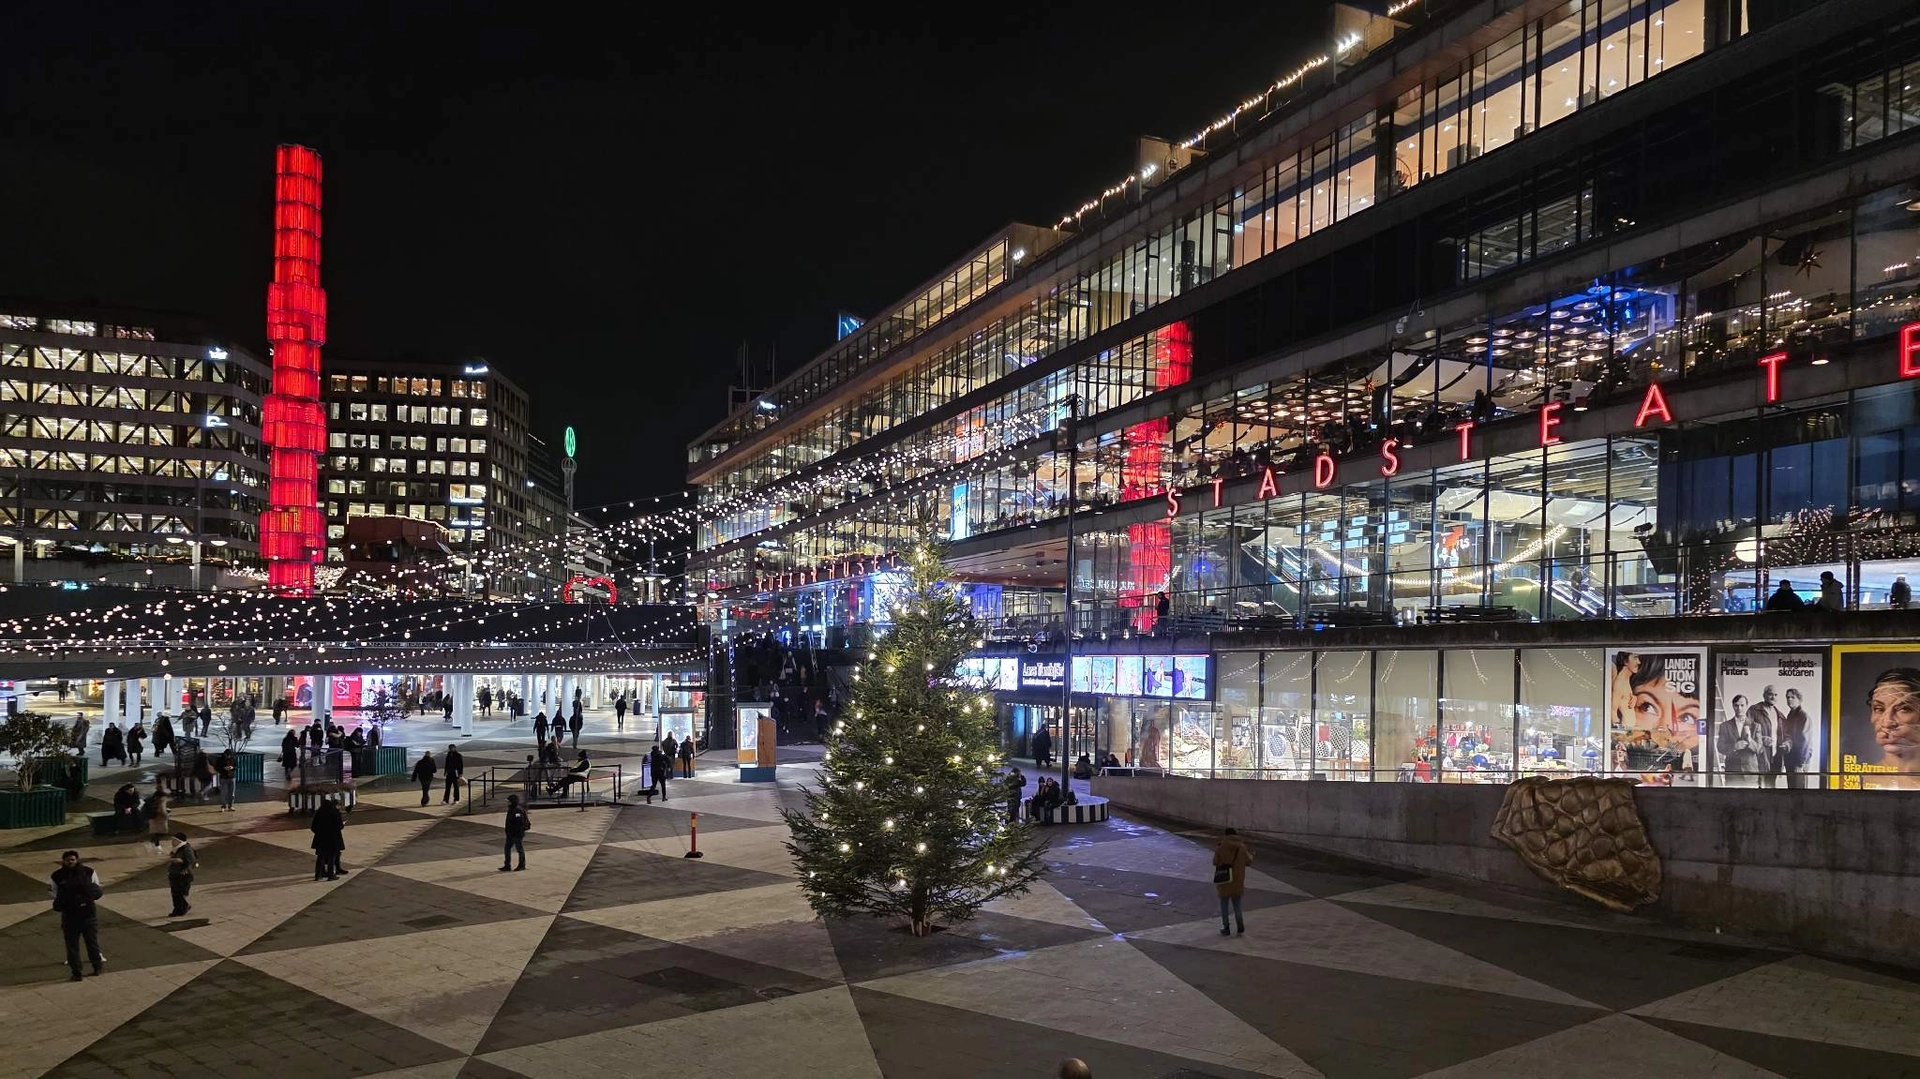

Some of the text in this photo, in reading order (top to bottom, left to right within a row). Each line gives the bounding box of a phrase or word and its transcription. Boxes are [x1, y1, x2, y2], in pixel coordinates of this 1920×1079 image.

[1664, 658, 1696, 670] LANDET
[1721, 658, 1748, 667] Harold
[1664, 670, 1695, 681] UTOM
[1721, 666, 1748, 676] Pinters
[1664, 681, 1695, 693] SIG
[1699, 720, 1707, 733] P
[1844, 754, 1857, 764] EN
